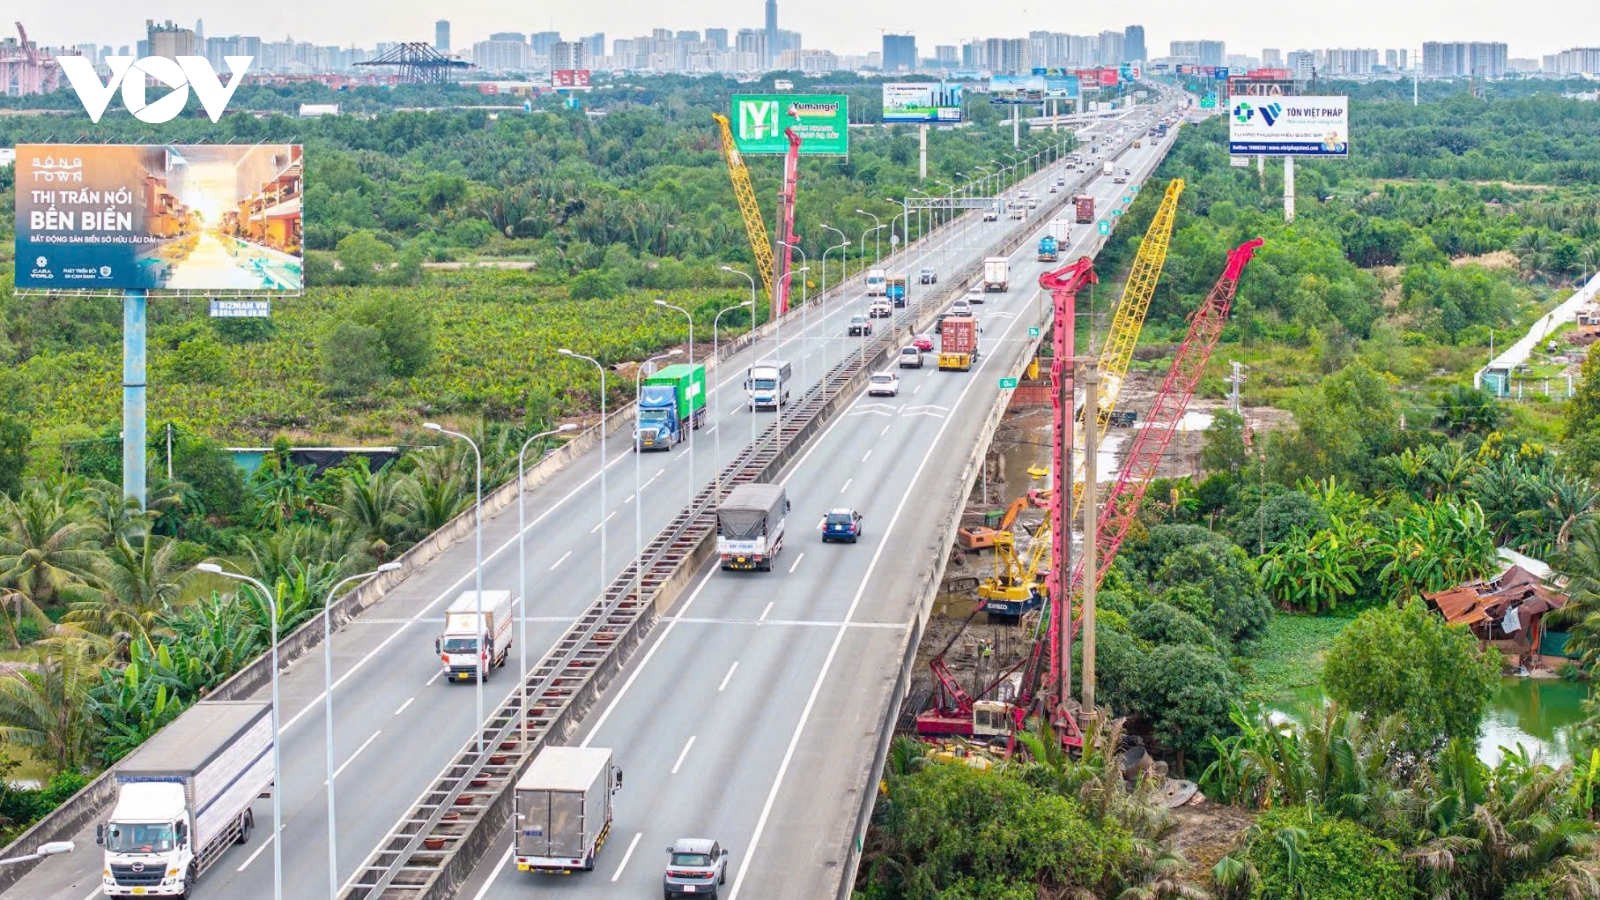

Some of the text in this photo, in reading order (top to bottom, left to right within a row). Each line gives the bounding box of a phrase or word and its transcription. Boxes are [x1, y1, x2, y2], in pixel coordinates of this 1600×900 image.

[793, 102, 839, 111] Yumangel
[1287, 106, 1343, 119] TÔN VIỆT PHÁP
[32, 155, 82, 167] SÔNG
[32, 171, 82, 182] TOWN
[31, 186, 132, 206] THỊ TRẤN NỔI
[81, 205, 132, 231] BIỂN
[45, 235, 68, 244] ĐỘNG
